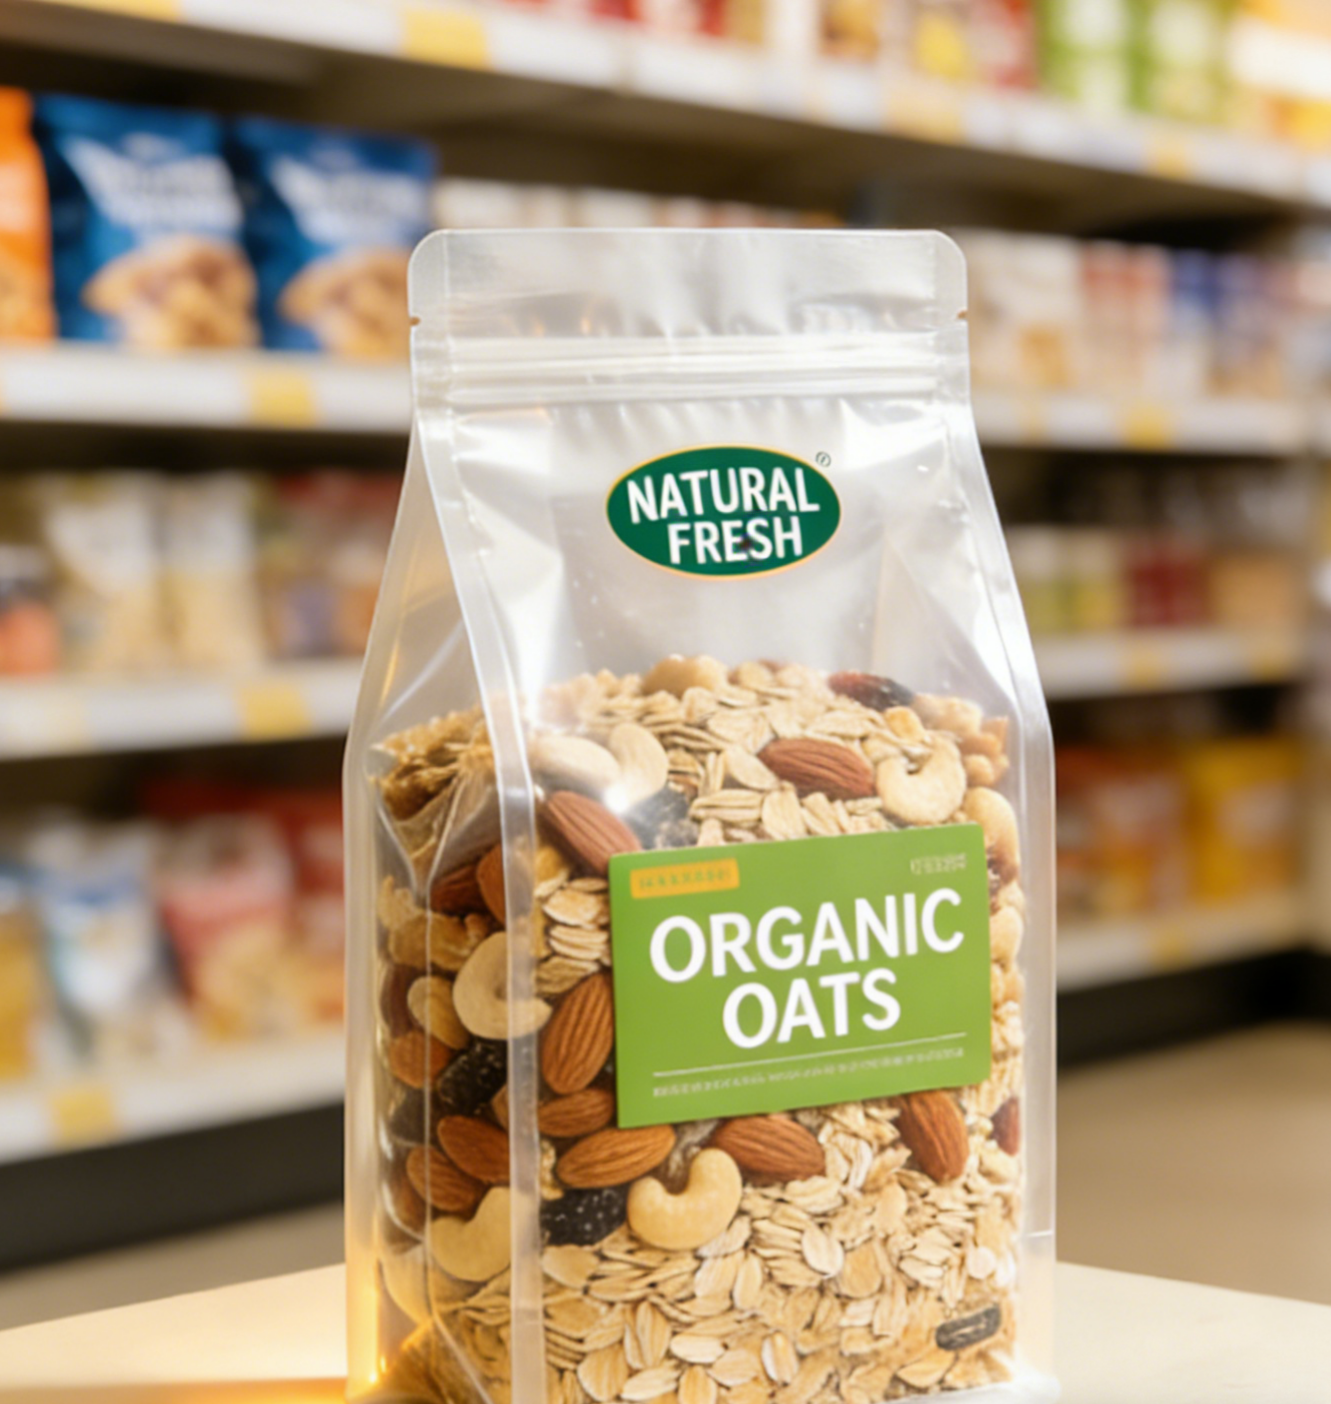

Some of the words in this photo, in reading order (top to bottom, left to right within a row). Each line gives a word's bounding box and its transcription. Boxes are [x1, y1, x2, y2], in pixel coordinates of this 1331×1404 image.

[627, 467, 820, 524] NATURAL
[668, 516, 803, 565] FRESH
[650, 888, 964, 983] ORGANIC
[723, 968, 901, 1049] OATS
